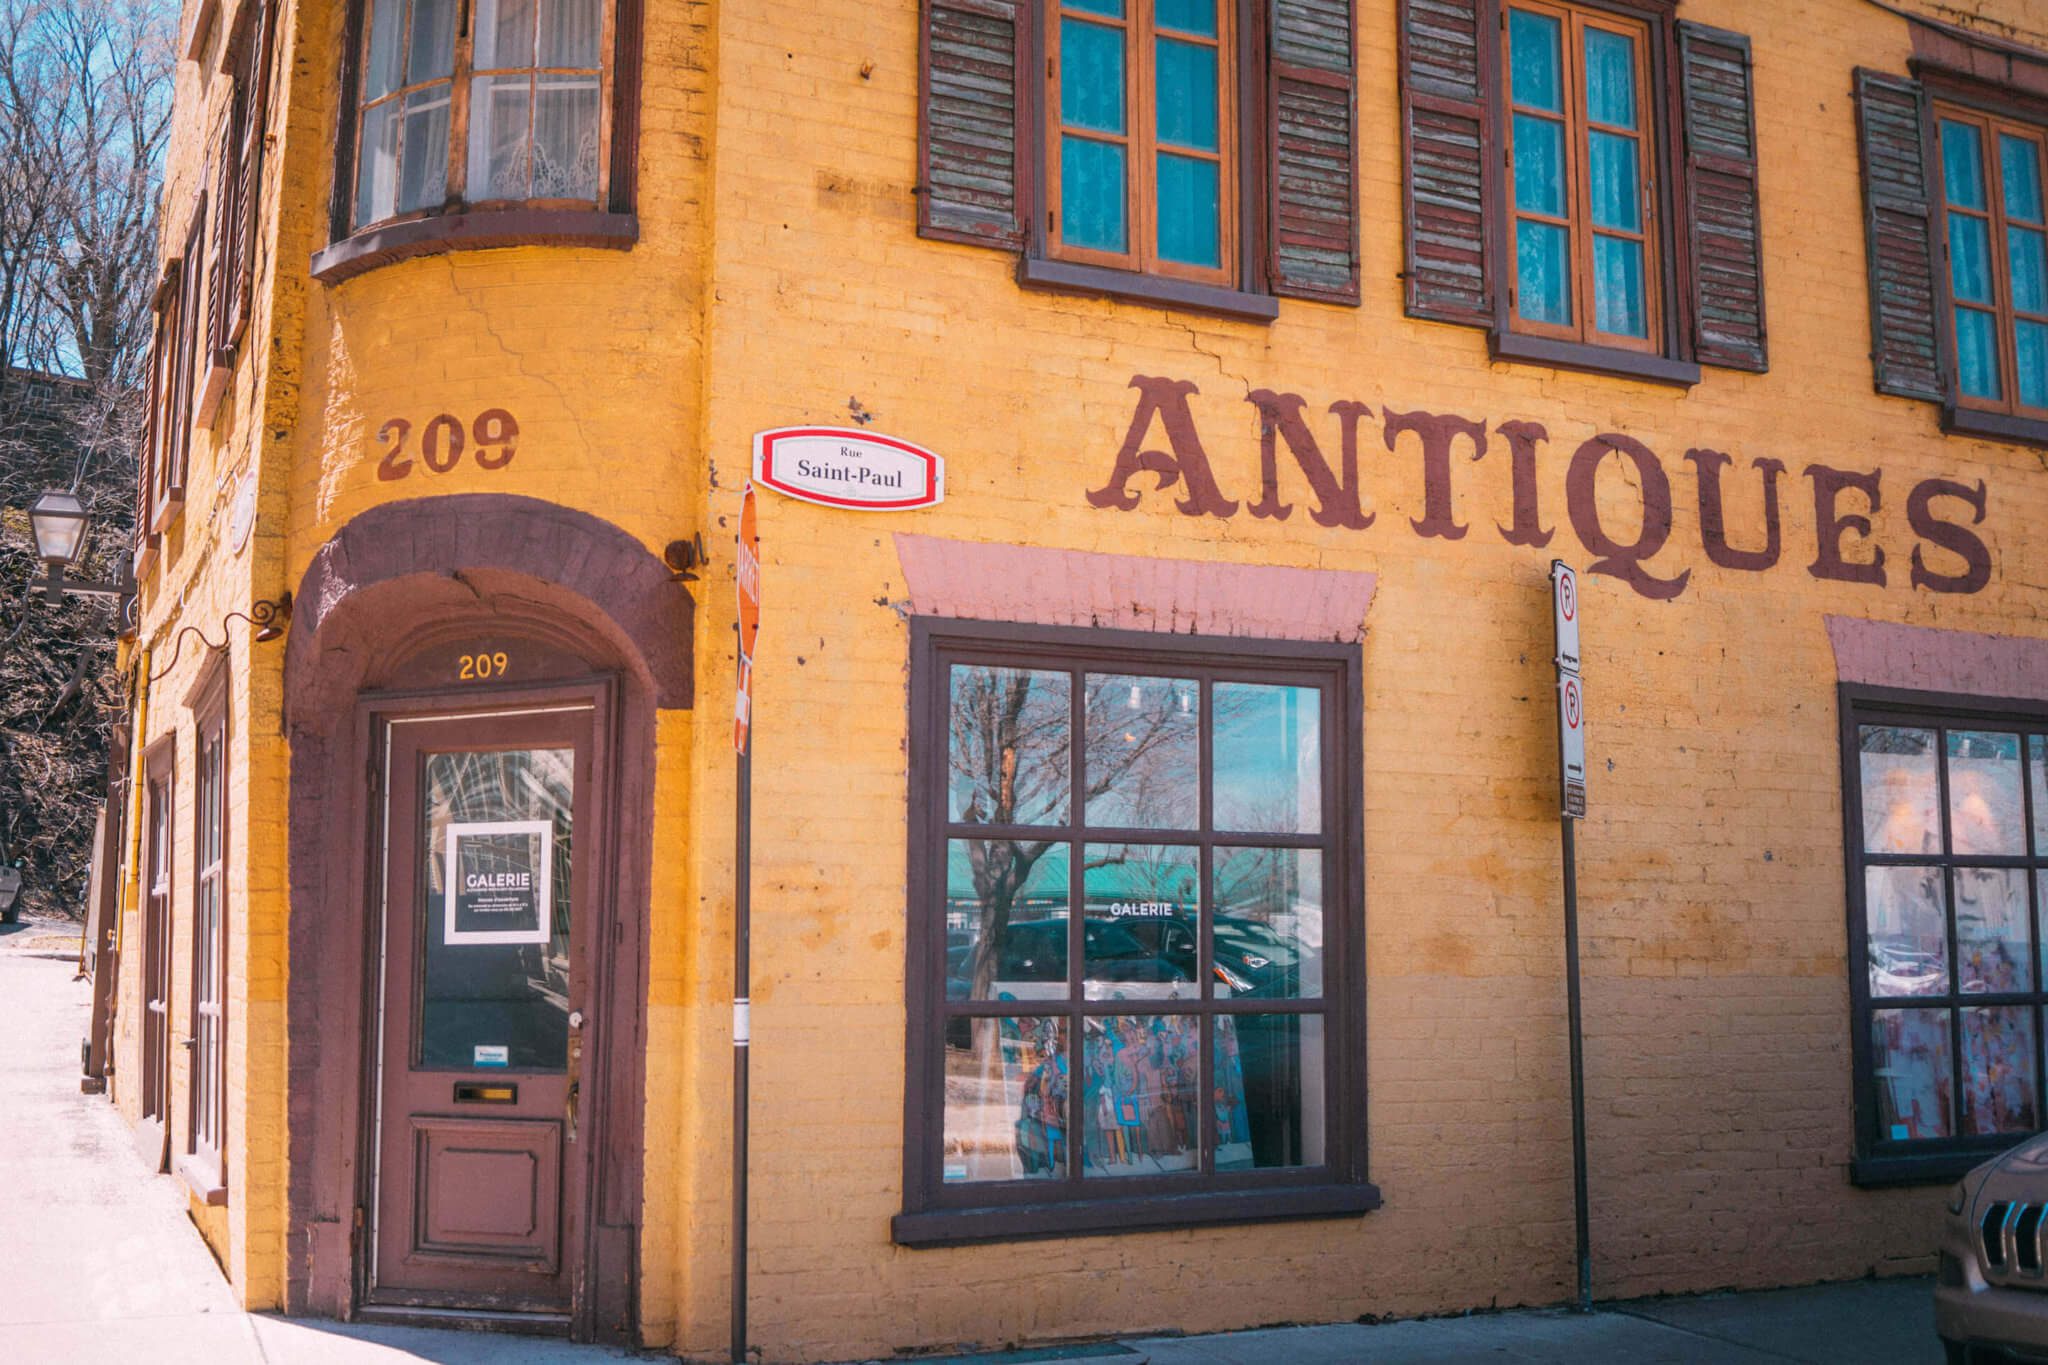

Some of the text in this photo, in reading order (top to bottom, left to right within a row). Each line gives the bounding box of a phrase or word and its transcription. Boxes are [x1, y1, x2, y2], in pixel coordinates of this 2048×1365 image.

[377, 408, 519, 481] 209
[840, 446, 862, 458] Rue
[797, 459, 902, 488] Saint-Paul
[1086, 374, 1993, 600] ANTIQUES
[459, 652, 508, 679] 209
[466, 873, 530, 887] GALERIE
[1110, 903, 1173, 916] GALERIE
